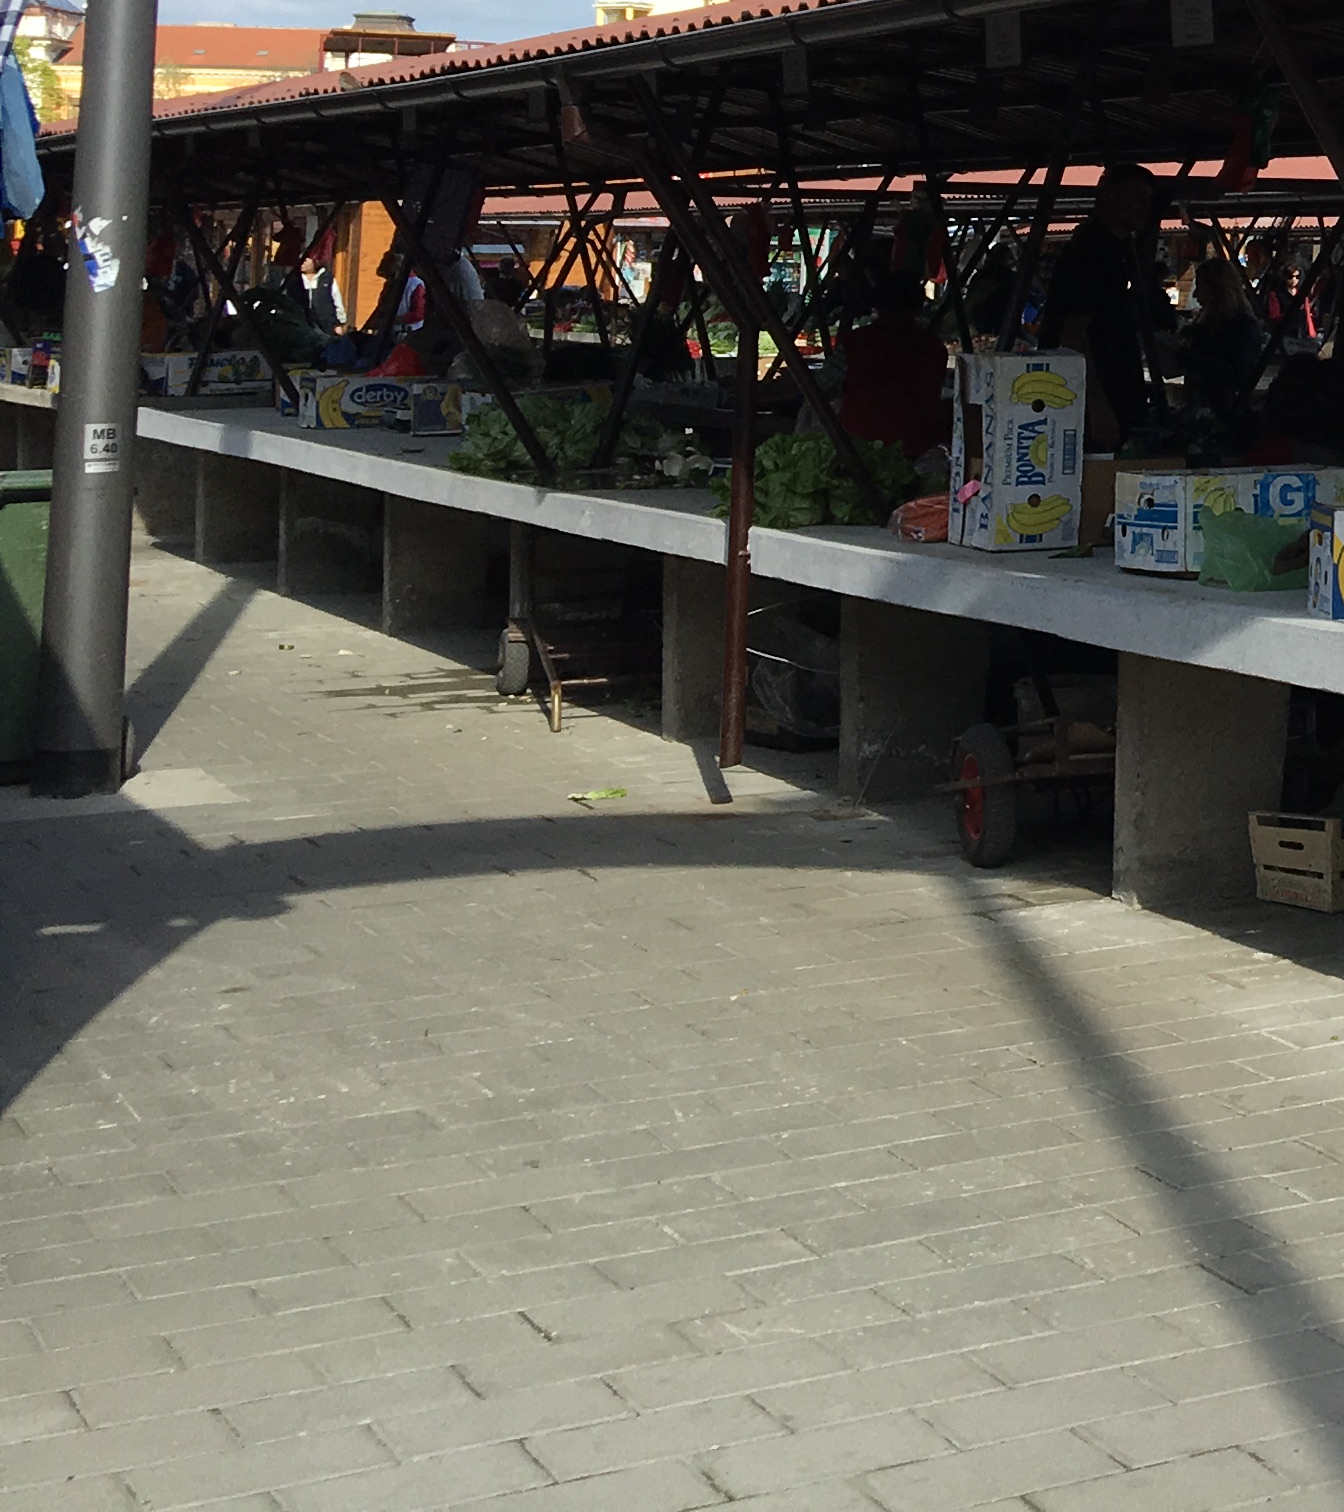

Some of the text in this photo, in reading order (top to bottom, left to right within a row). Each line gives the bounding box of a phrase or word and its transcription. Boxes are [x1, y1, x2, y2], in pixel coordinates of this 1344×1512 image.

[353, 385, 406, 405] derby
[89, 442, 118, 455] 6.40
[978, 371, 996, 530] BANANAS
[1015, 417, 1048, 487] BONITA
